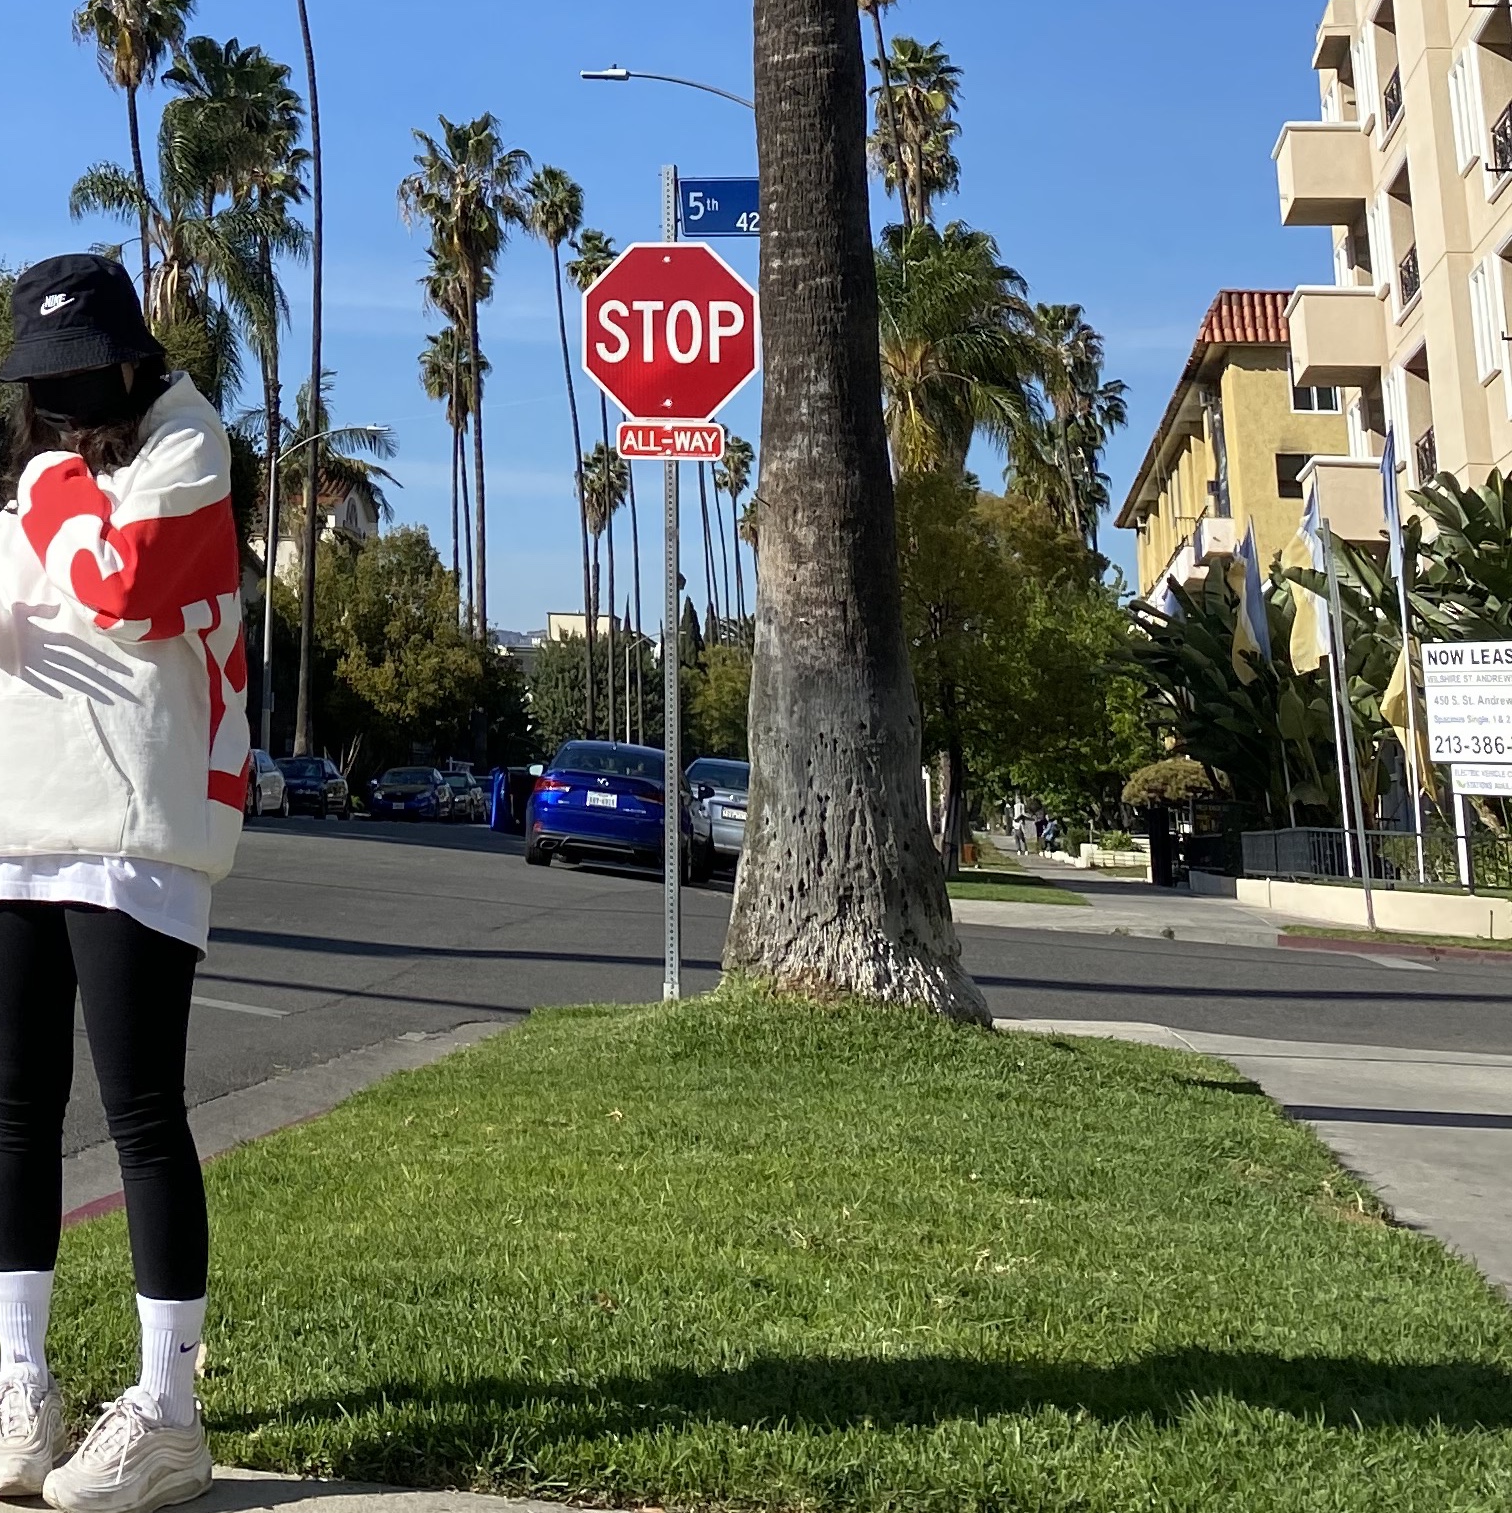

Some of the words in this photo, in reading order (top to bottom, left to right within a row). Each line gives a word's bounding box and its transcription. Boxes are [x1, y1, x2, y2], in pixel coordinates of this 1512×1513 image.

[689, 192, 719, 220] 5th
[44, 293, 67, 308] NIKE
[595, 299, 745, 364] STOP
[622, 430, 718, 452] ALL-WAY
[1427, 649, 1464, 665] NOW
[1471, 648, 1512, 664] LEAS
[1476, 674, 1512, 683] ANDREW
[1434, 695, 1449, 706] 450
[1435, 735, 1512, 755] 213-386-
